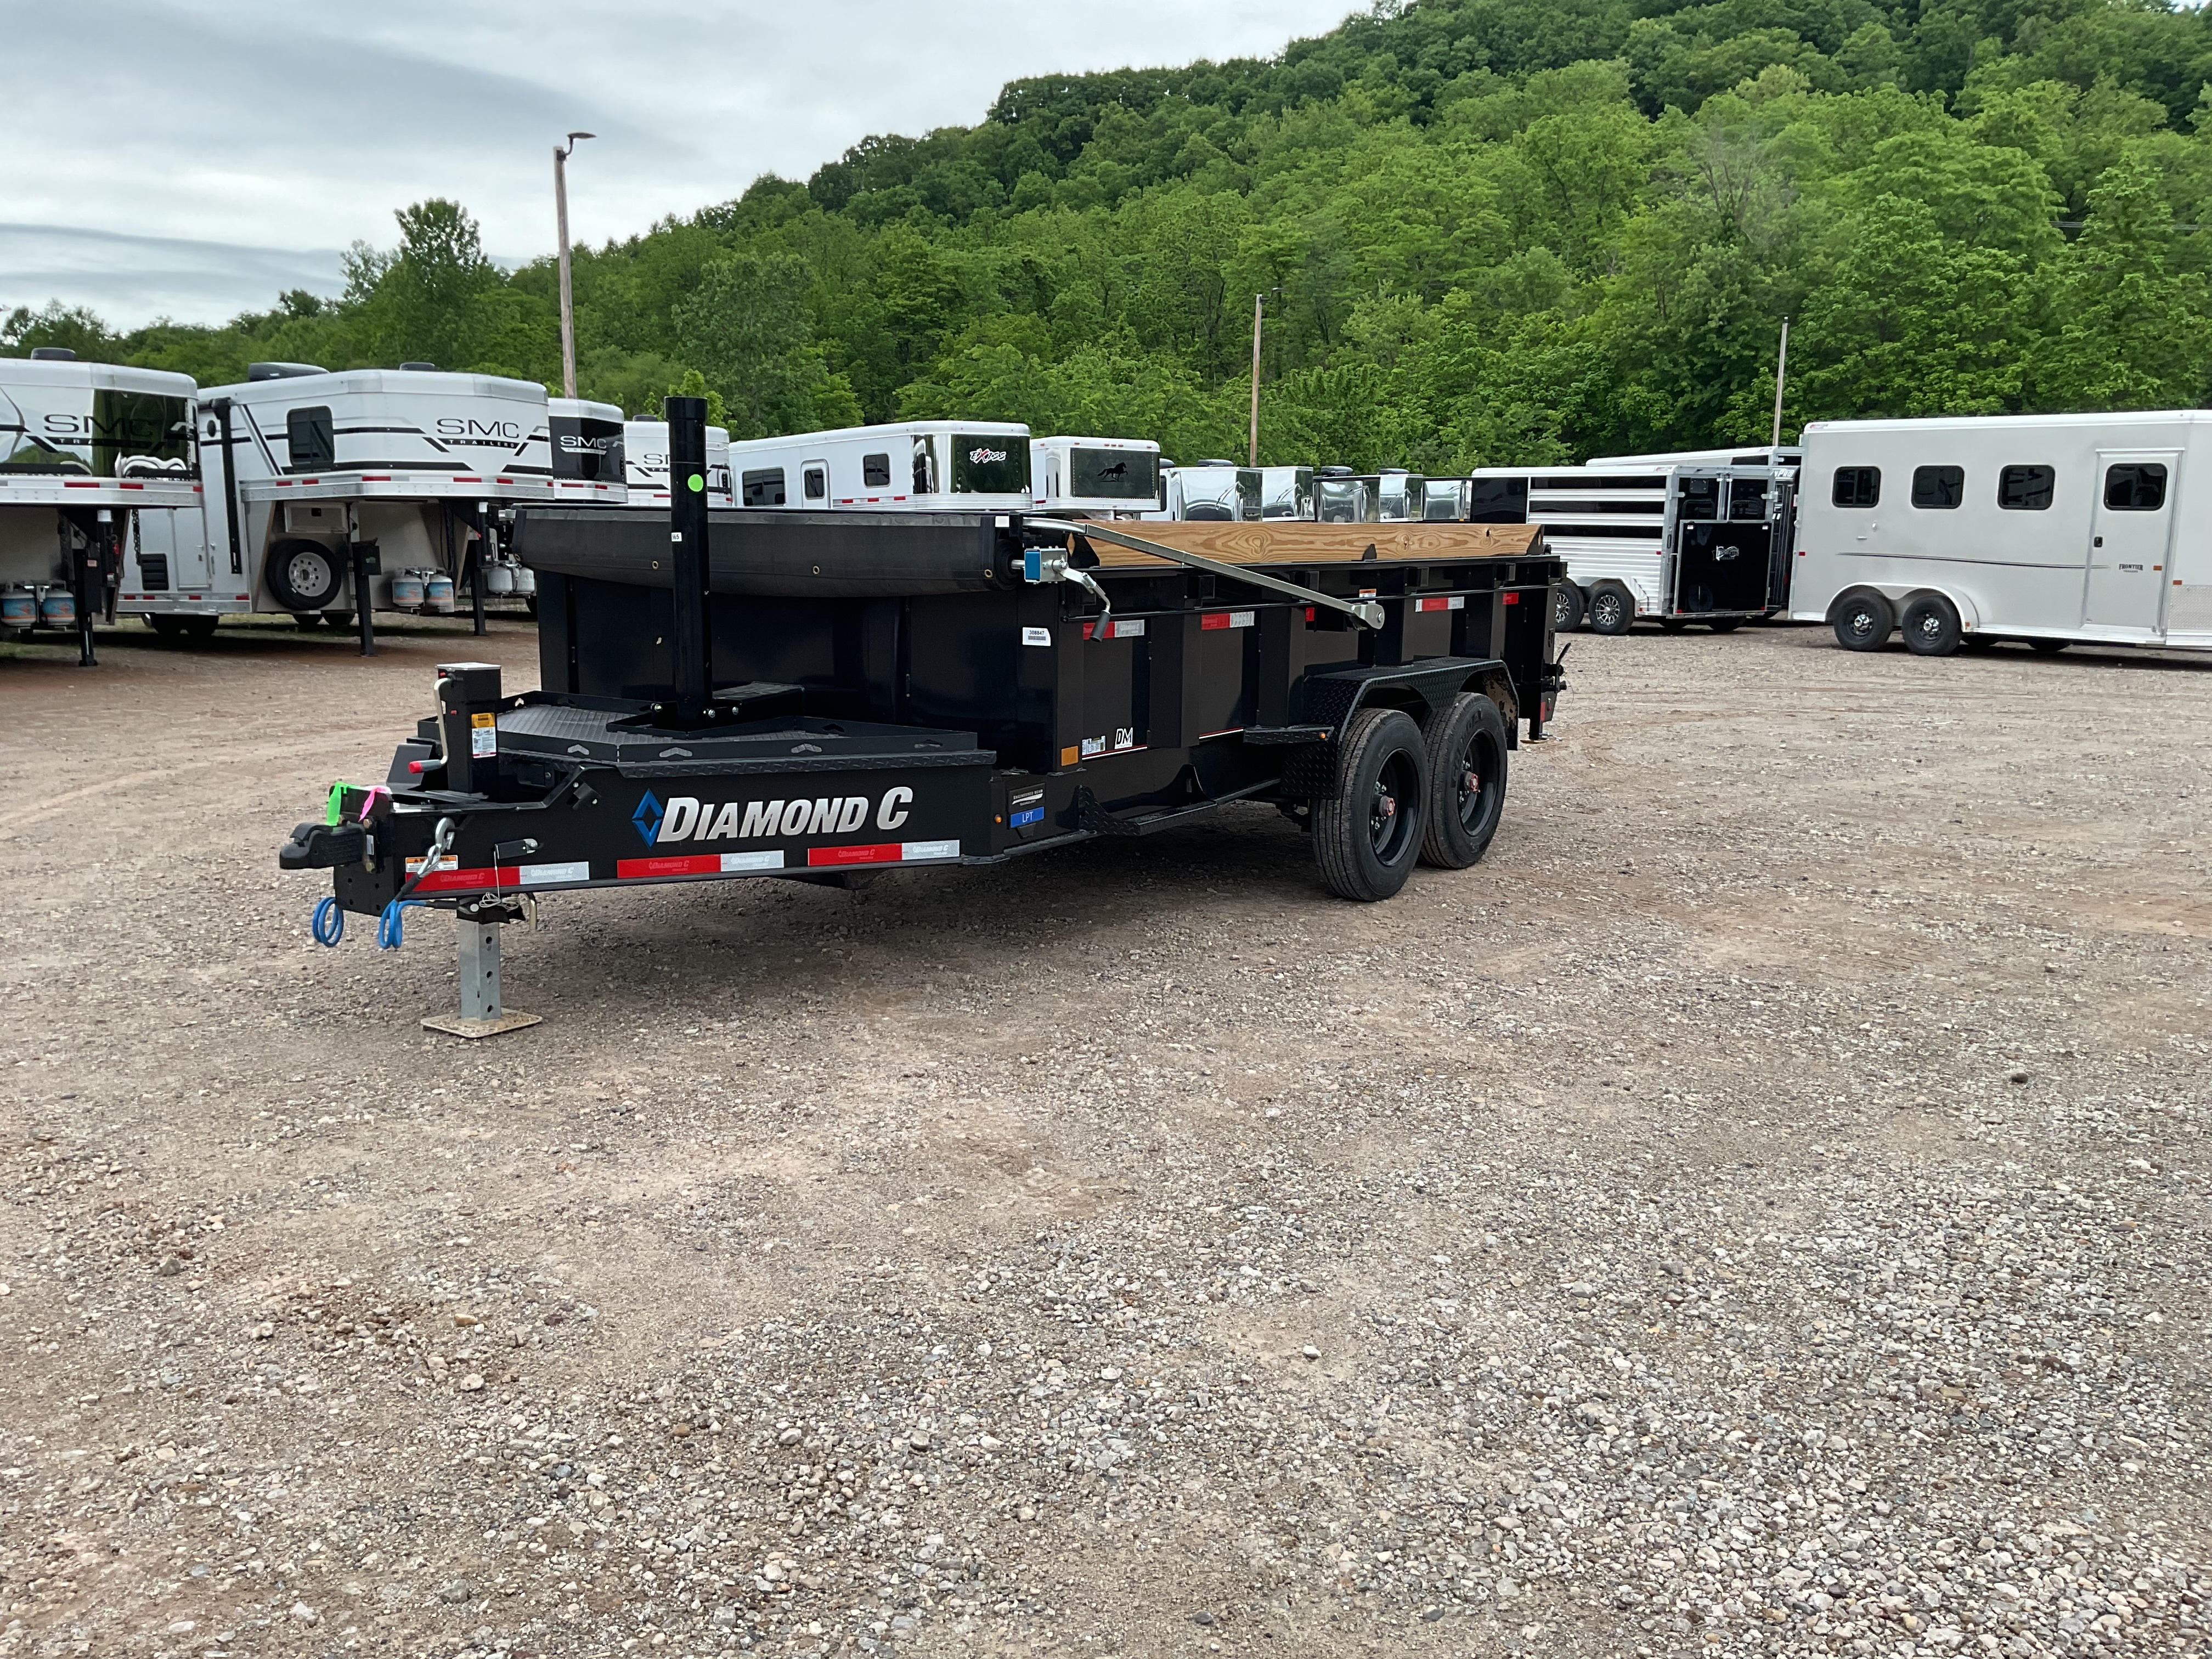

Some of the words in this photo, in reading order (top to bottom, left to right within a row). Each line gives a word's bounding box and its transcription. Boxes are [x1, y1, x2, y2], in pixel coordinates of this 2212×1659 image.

[44, 414, 154, 437] SMC
[437, 419, 520, 438] SMC
[560, 436, 607, 449] SMC
[1116, 729, 1132, 745] DM
[657, 797, 869, 843] DIAMOND
[877, 786, 913, 830] C
[1022, 811, 1034, 822] LPT
